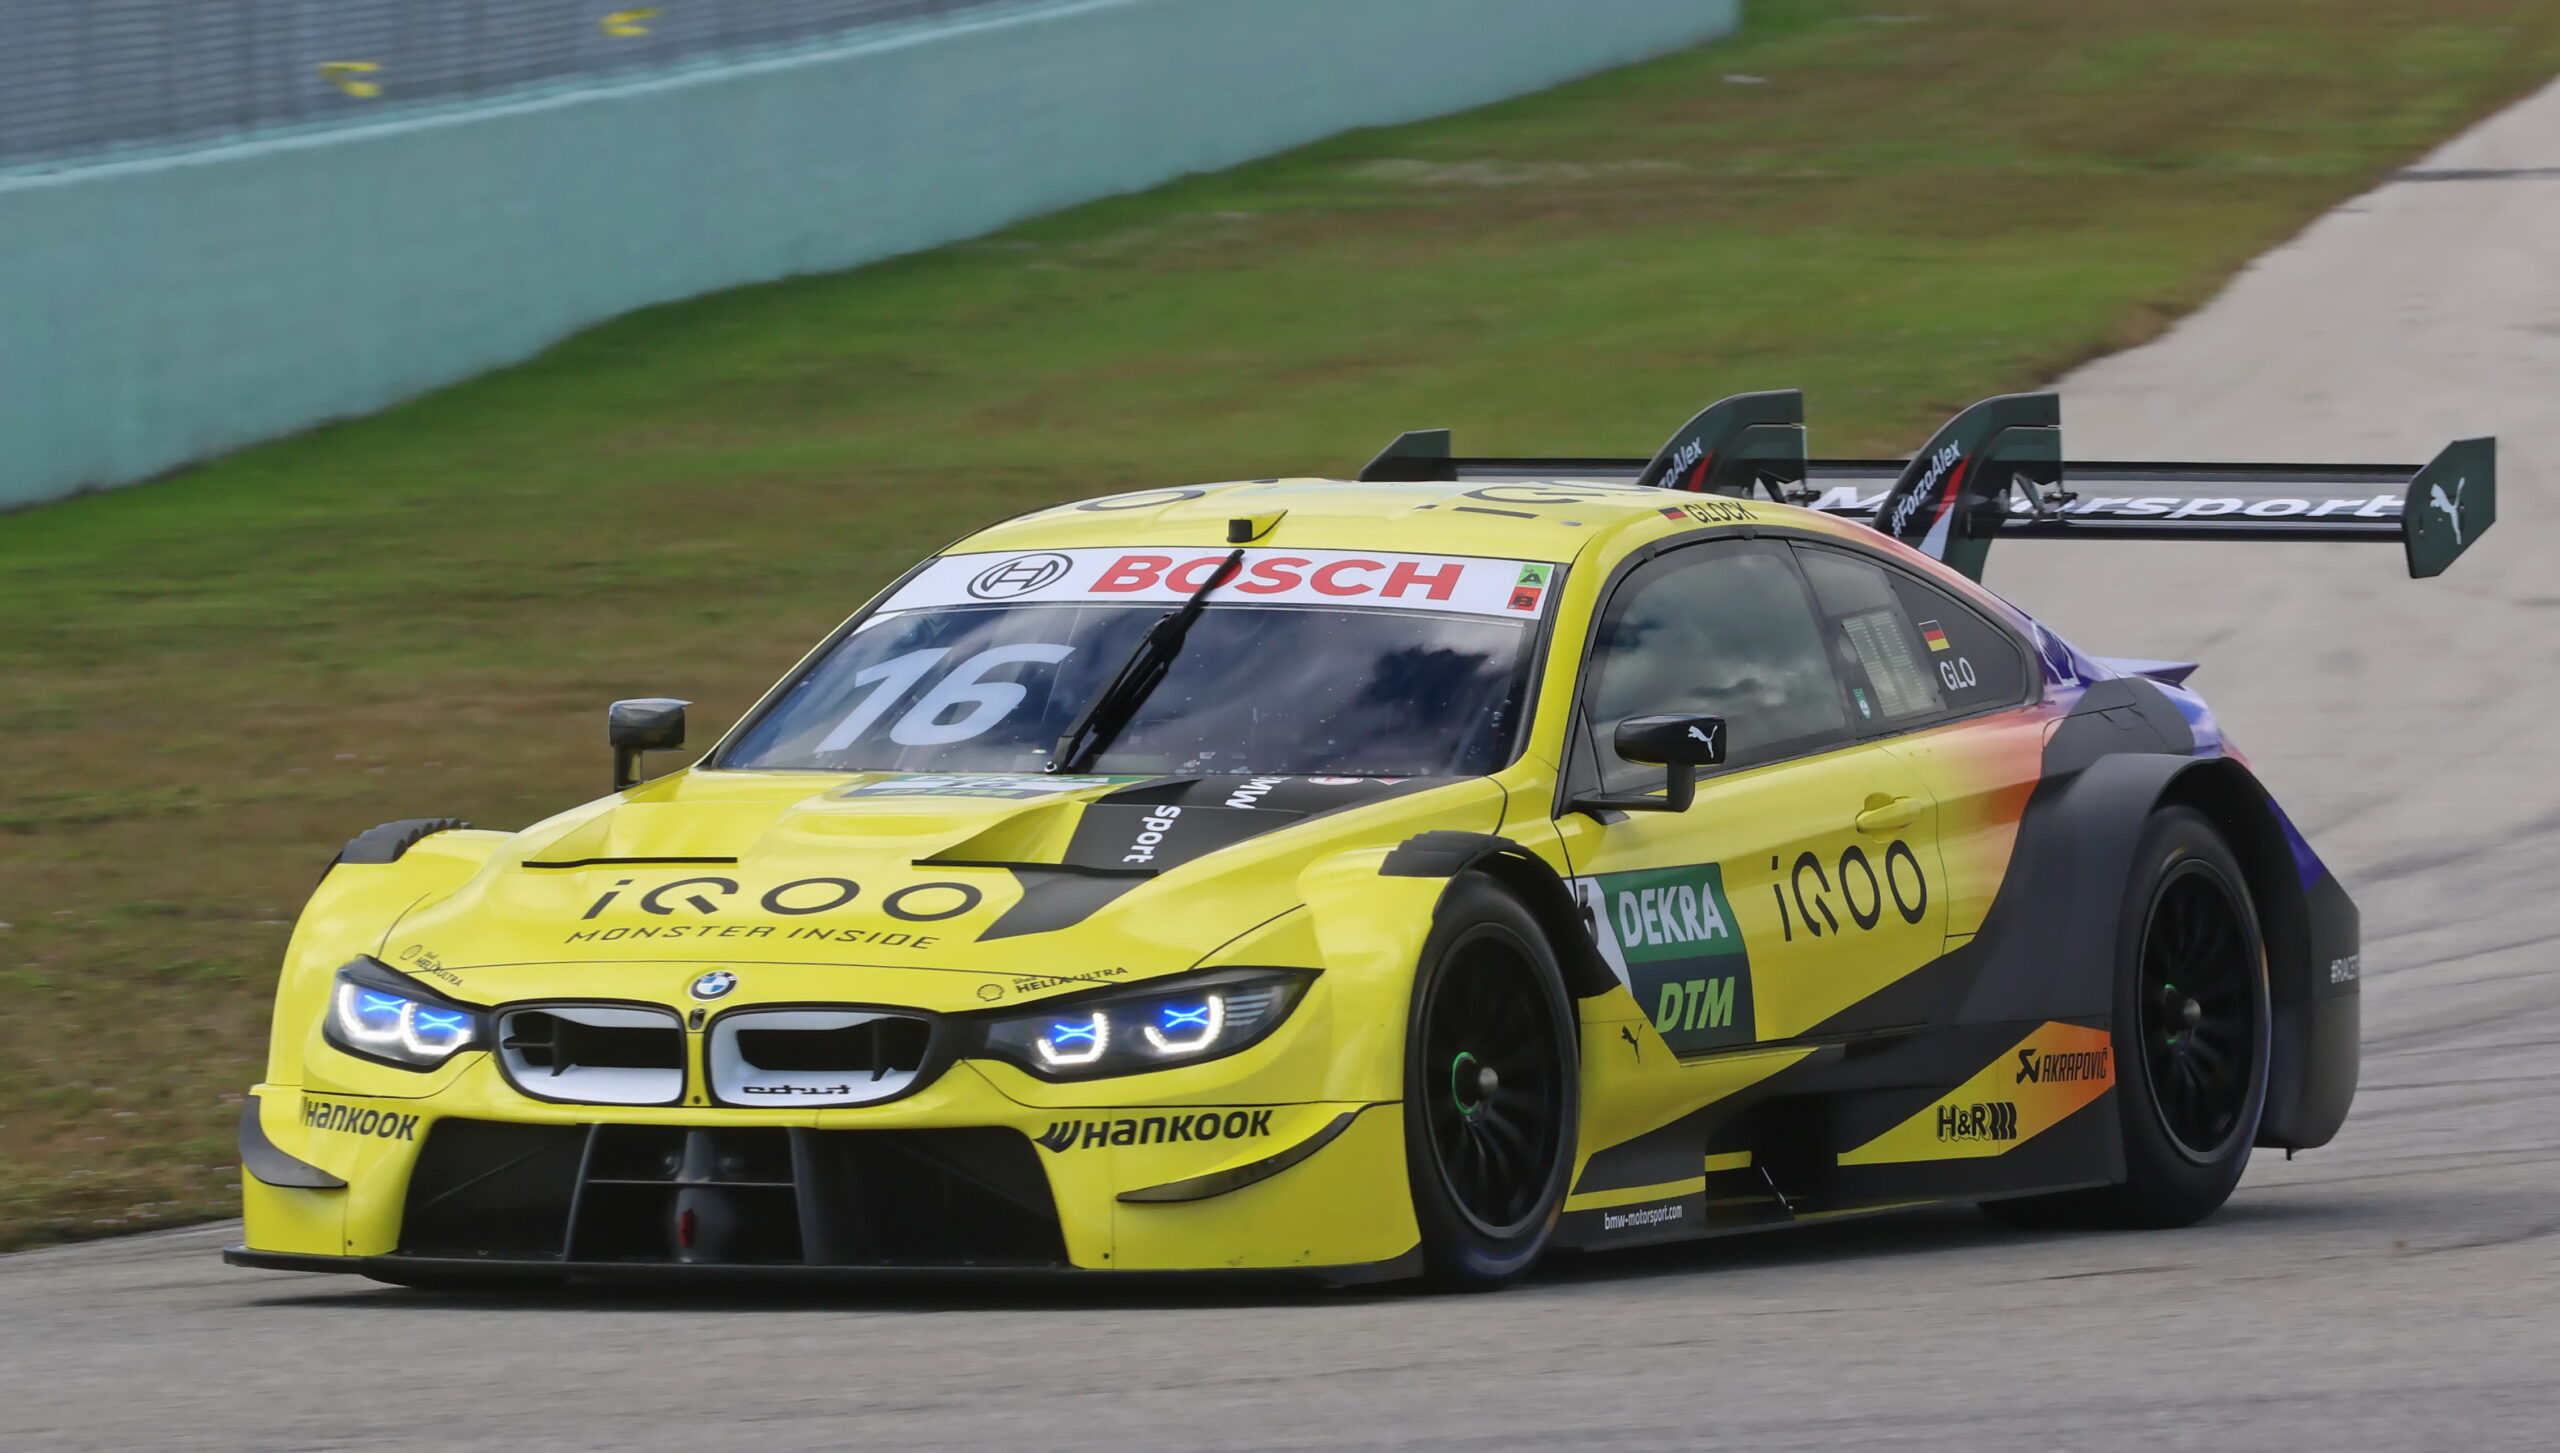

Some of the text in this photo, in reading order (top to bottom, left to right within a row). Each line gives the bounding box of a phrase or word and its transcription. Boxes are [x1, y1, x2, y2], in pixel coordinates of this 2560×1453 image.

[1892, 439, 1961, 538] #ForzaAlex
[1683, 502, 1759, 524] GLOCK
[1088, 554, 1466, 601] BOSCH
[1939, 656, 1977, 691] GLO
[812, 643, 1077, 752] 16
[581, 876, 983, 923] iQOO
[1771, 839, 1928, 943] iQOO
[564, 925, 776, 944] MONSTER
[1618, 882, 1728, 949] DEKRA
[787, 927, 941, 949] INSIDE
[1016, 967, 1128, 993] HELIX ULTRA
[1656, 976, 1736, 1034] DTM
[1937, 1104, 1991, 1142] H&R
[1604, 1204, 1683, 1231] bmw-motorsport.com
